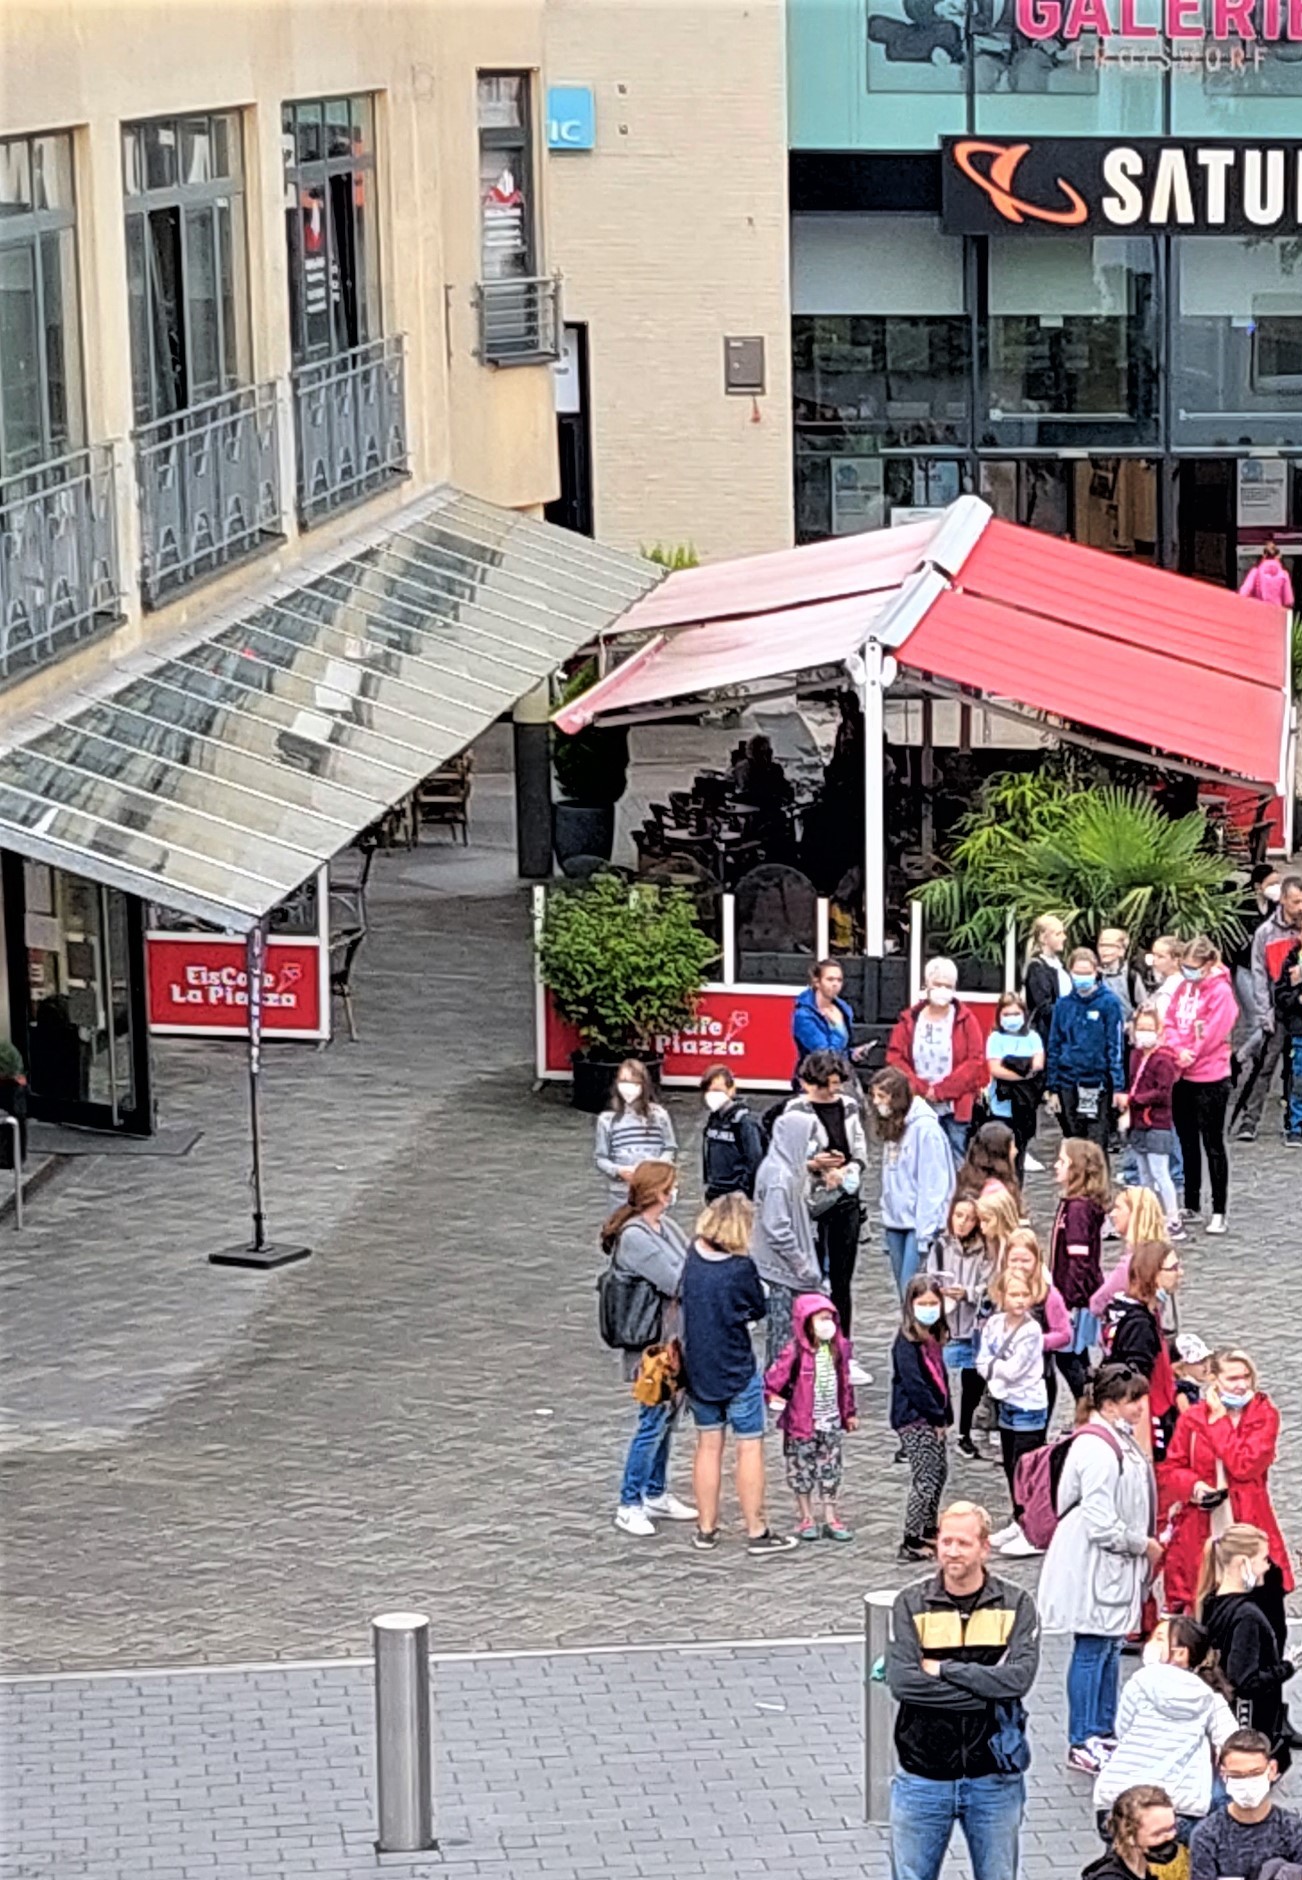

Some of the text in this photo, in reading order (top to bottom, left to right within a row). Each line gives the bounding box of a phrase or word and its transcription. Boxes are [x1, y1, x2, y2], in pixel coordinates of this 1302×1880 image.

[1072, 46, 1269, 73] TROISDORF
[185, 965, 276, 987] EisCae
[169, 983, 297, 1008] La Piaza
[655, 1030, 745, 1056] Piazza
